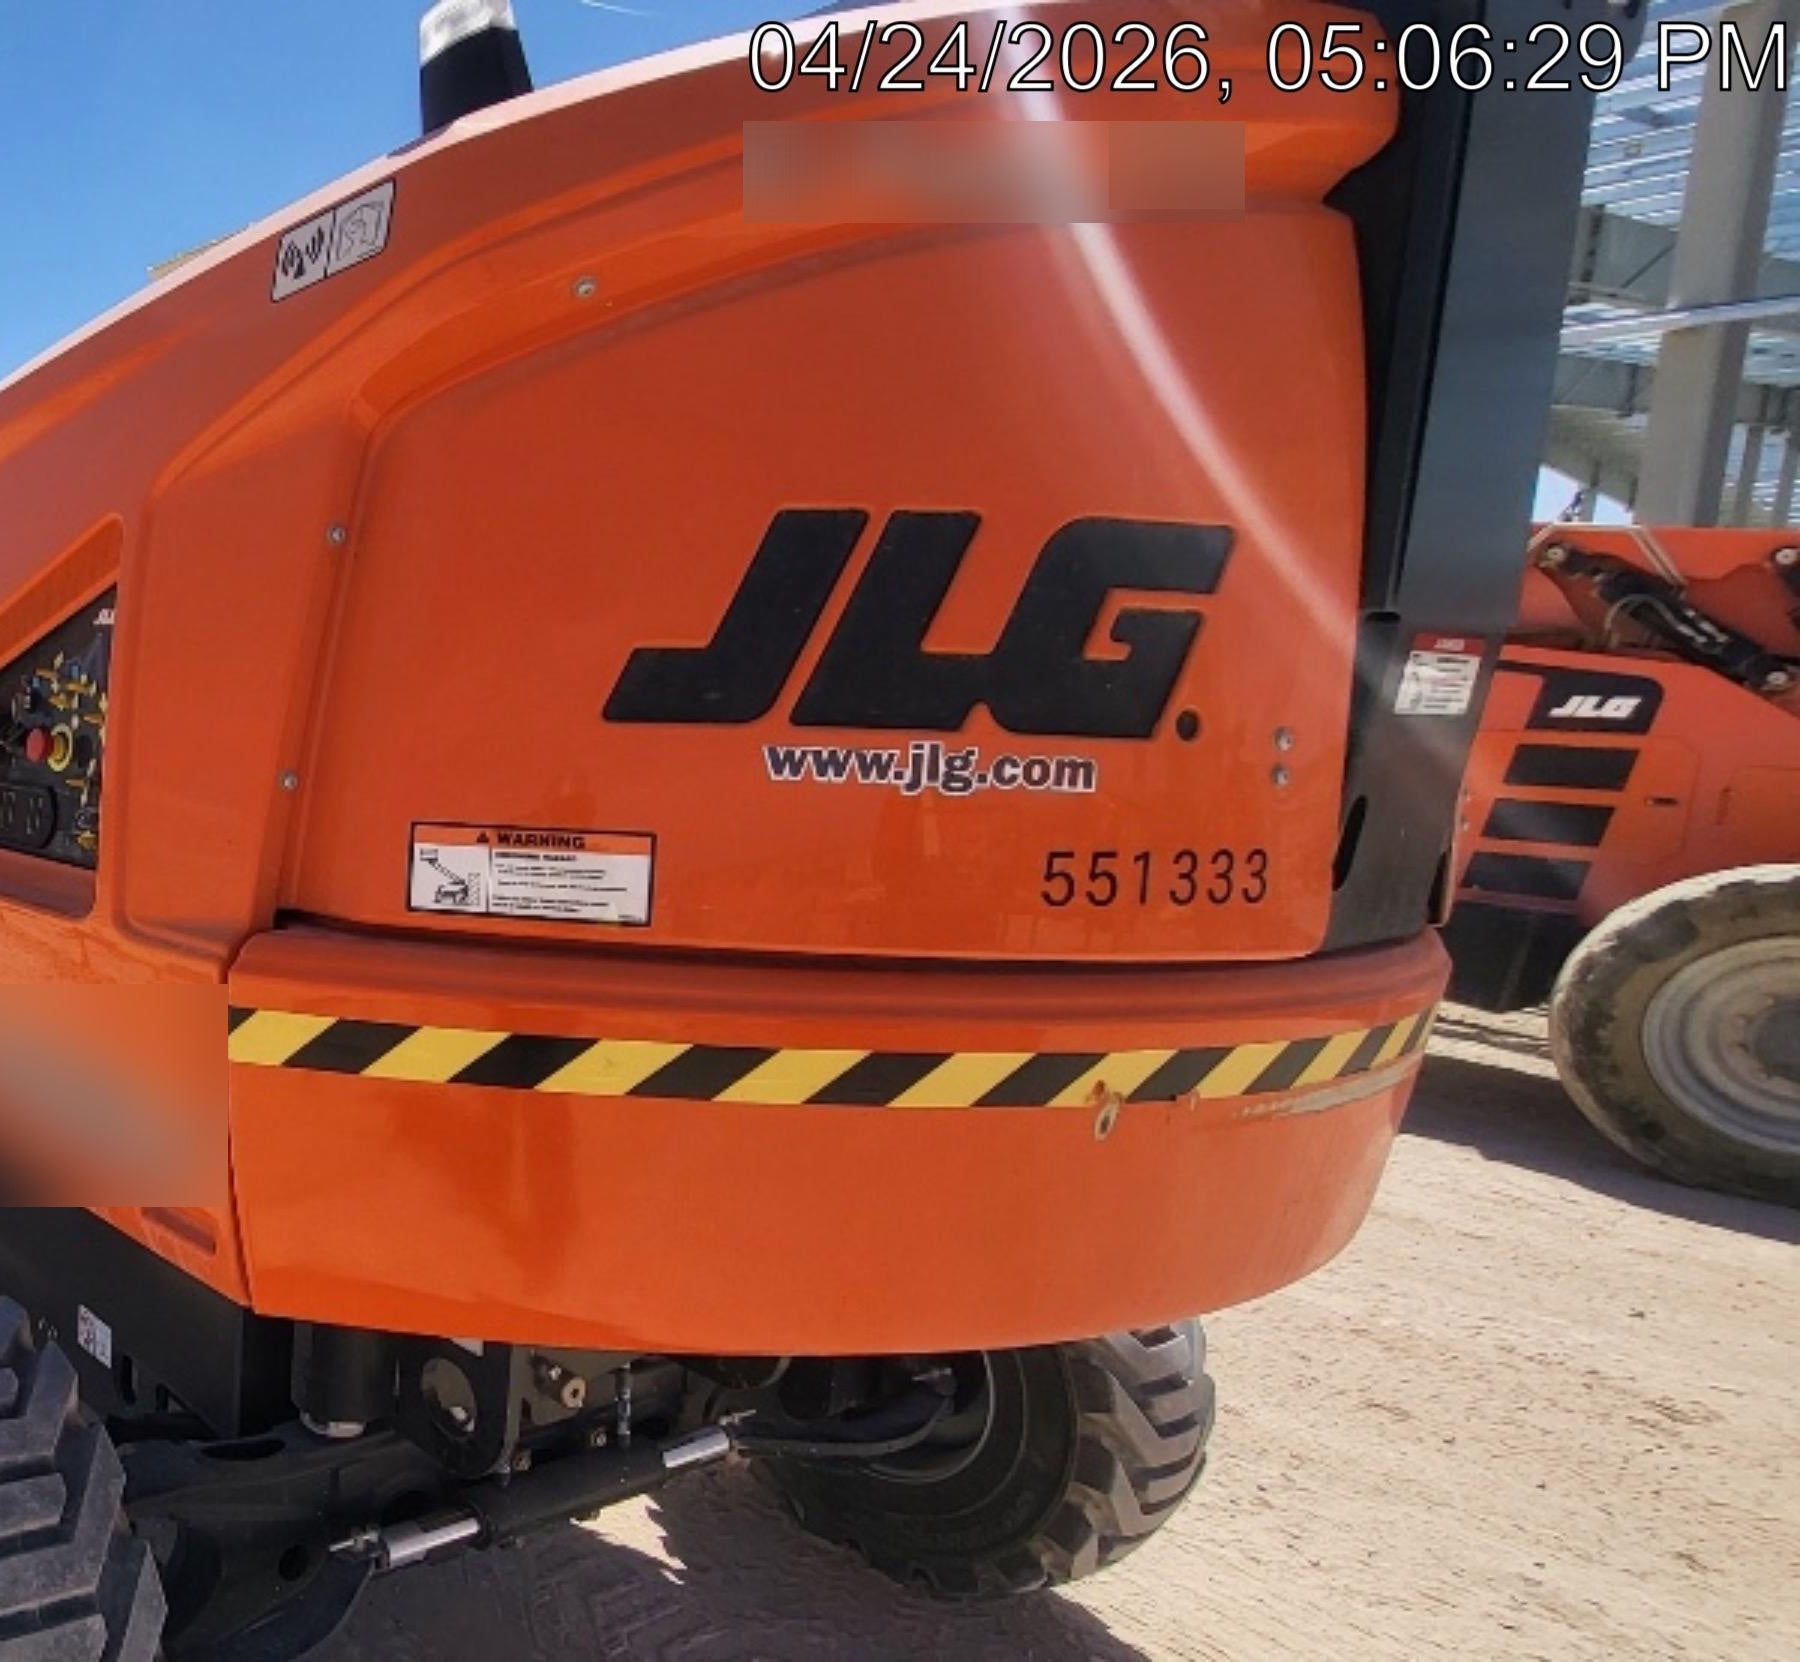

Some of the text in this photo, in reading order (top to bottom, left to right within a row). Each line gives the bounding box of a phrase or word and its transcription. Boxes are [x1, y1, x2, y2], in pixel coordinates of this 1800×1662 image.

[92, 608, 115, 625] JL
[1548, 695, 1642, 718] JLG
[765, 741, 1096, 795] www.jlg.com
[497, 832, 586, 850] WARNING
[1040, 848, 1269, 907] 551333
